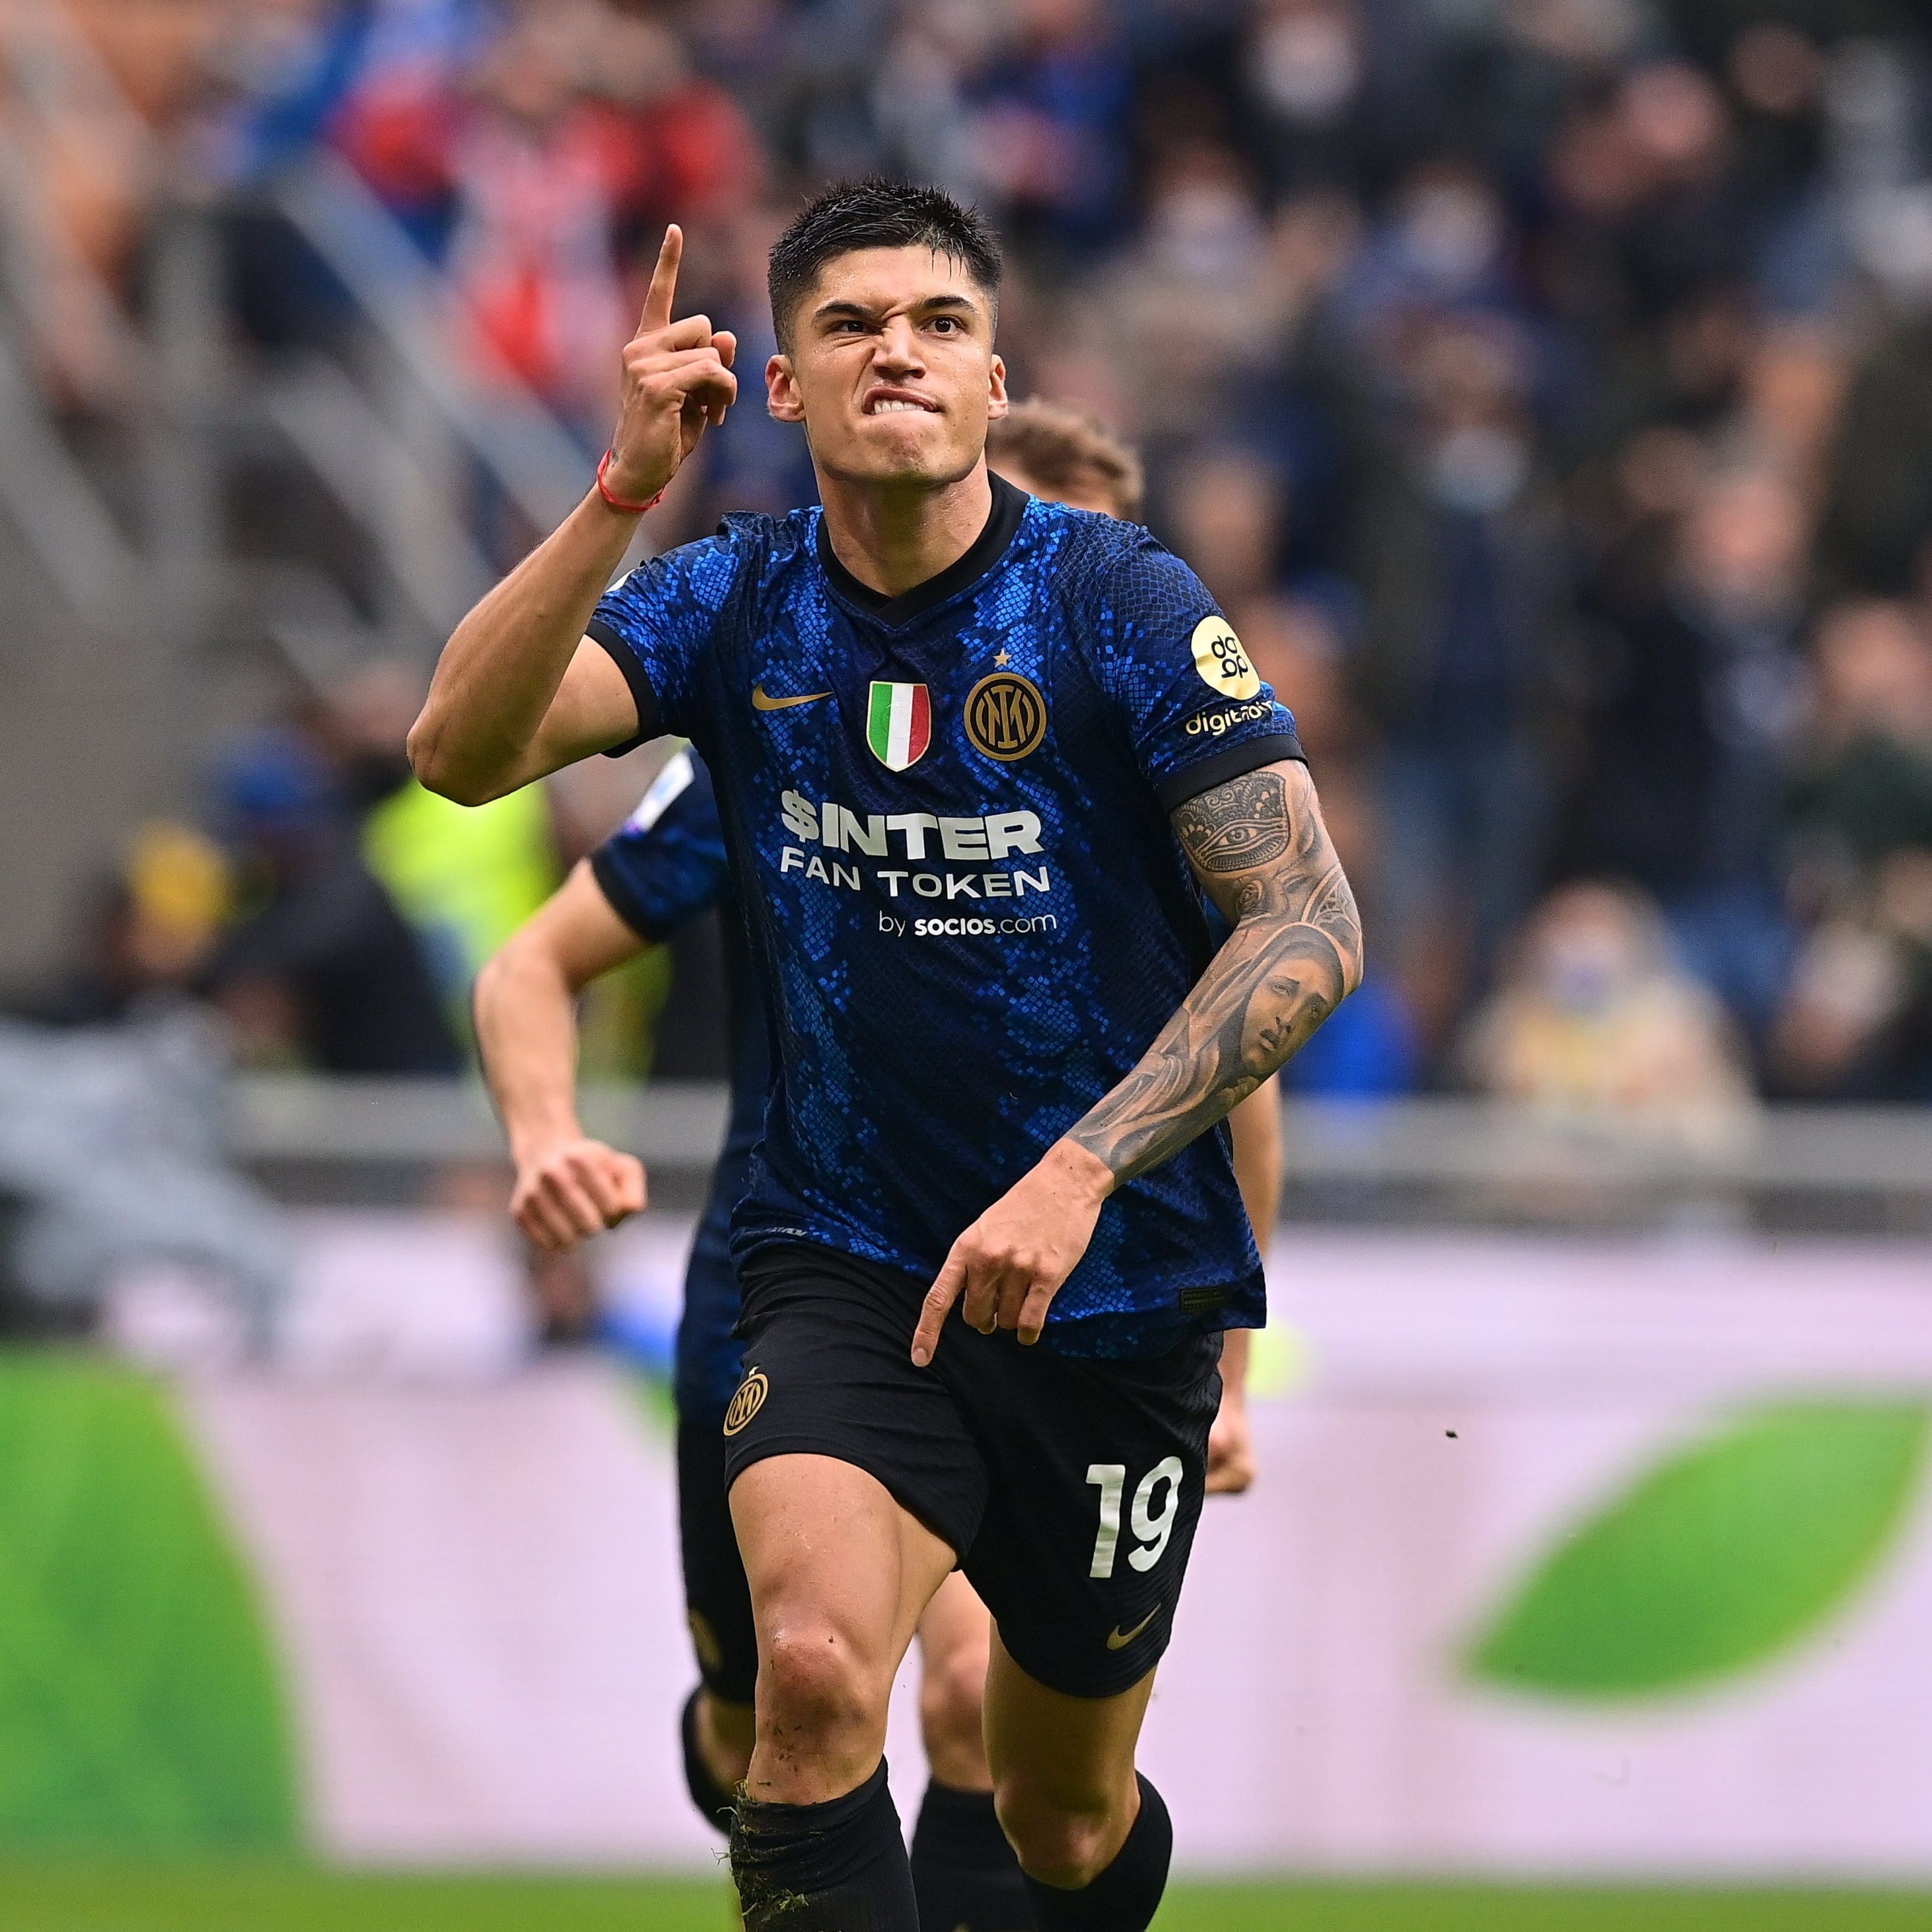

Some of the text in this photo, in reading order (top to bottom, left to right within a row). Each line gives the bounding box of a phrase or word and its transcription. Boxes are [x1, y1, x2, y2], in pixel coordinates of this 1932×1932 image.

[781, 789, 1045, 860] $INTER
[780, 845, 1050, 900] FAN TOKEN
[878, 910, 906, 937] by
[1085, 1456, 1184, 1578] 19
